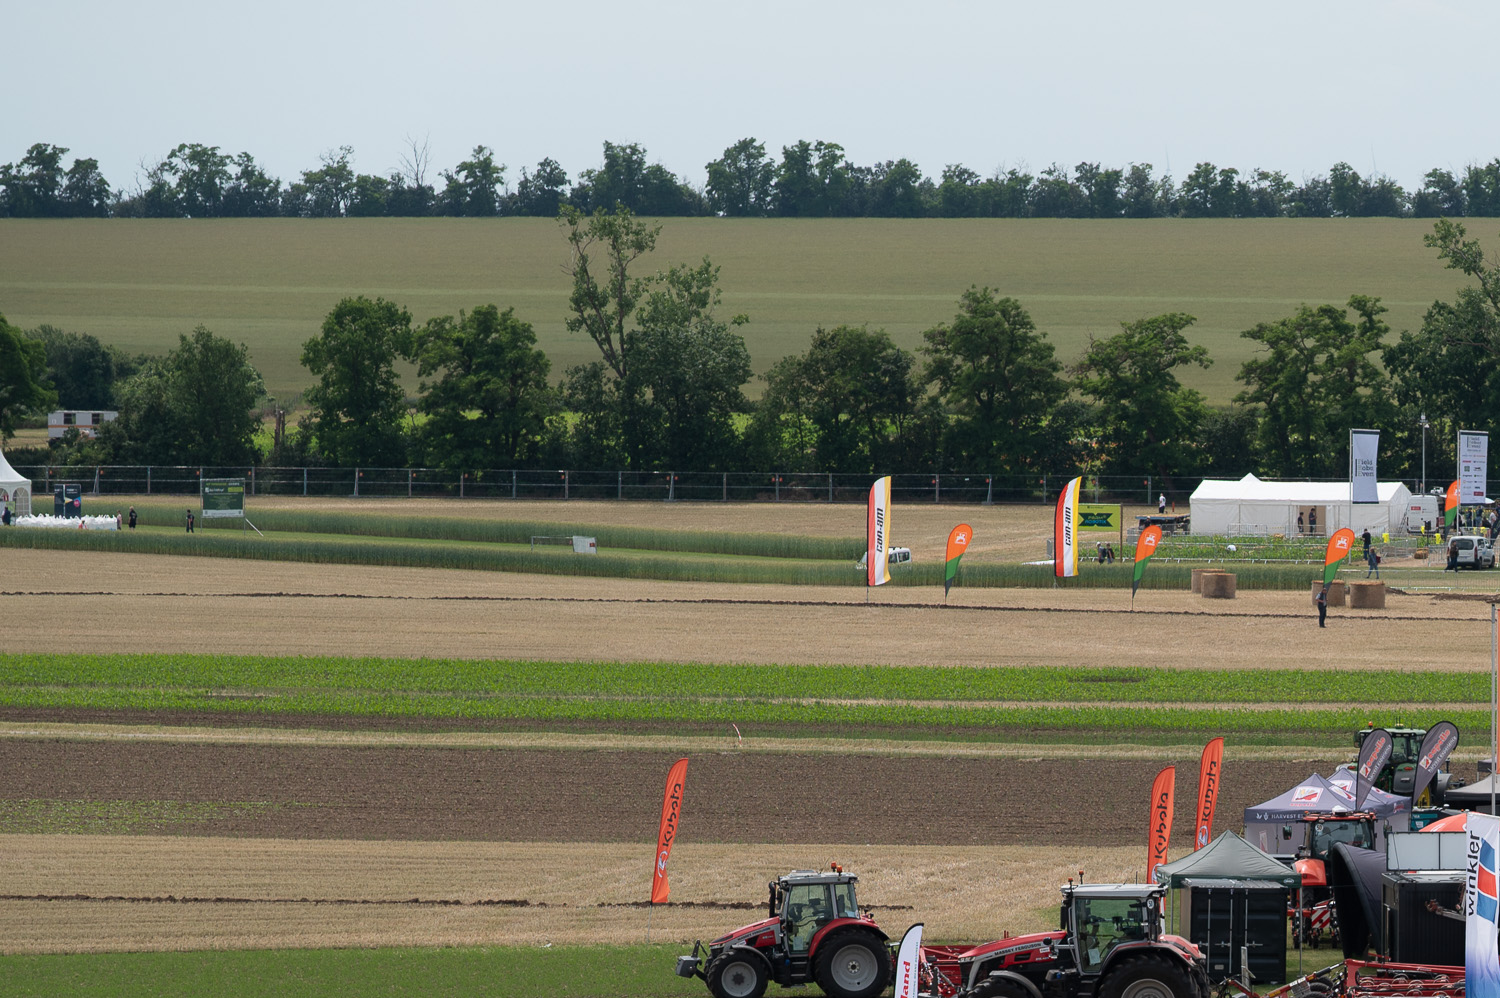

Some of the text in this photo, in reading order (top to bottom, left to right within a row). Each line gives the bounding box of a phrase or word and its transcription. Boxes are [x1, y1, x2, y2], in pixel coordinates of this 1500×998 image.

[876, 507, 885, 553] can-am
[1366, 737, 1386, 767] capello
[1427, 729, 1451, 759] capello
[662, 783, 682, 847] Kubota
[1201, 759, 1216, 821] Kubota
[1154, 792, 1169, 859] Kubota
[1467, 830, 1481, 916] winkler
[1014, 943, 1042, 952] FERGUSON
